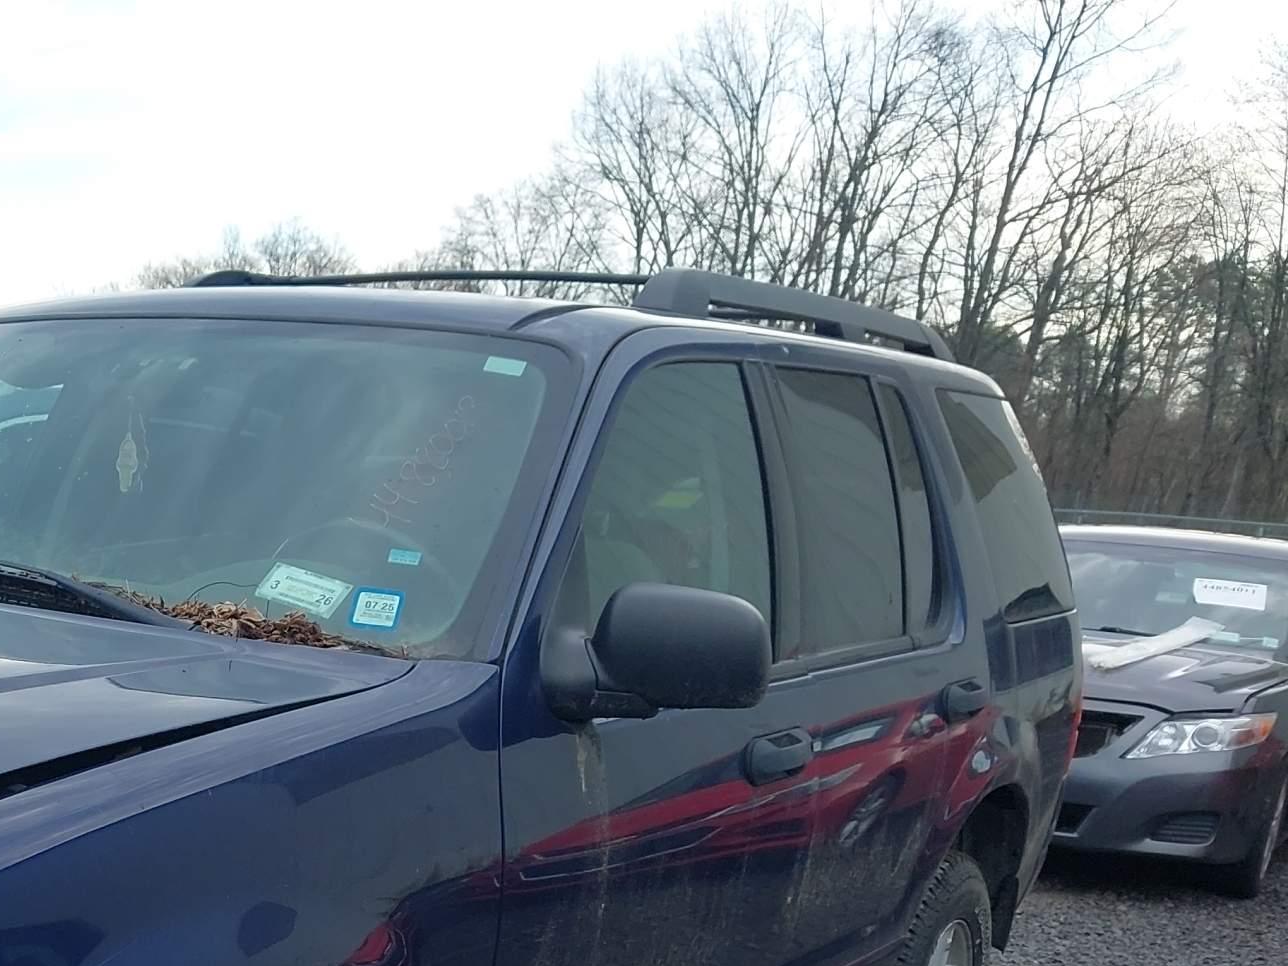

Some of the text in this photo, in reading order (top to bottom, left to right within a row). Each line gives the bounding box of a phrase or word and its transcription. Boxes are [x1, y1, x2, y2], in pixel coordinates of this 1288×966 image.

[270, 580, 281, 590] 3
[315, 594, 334, 606] 26
[365, 600, 394, 612] 07 25
